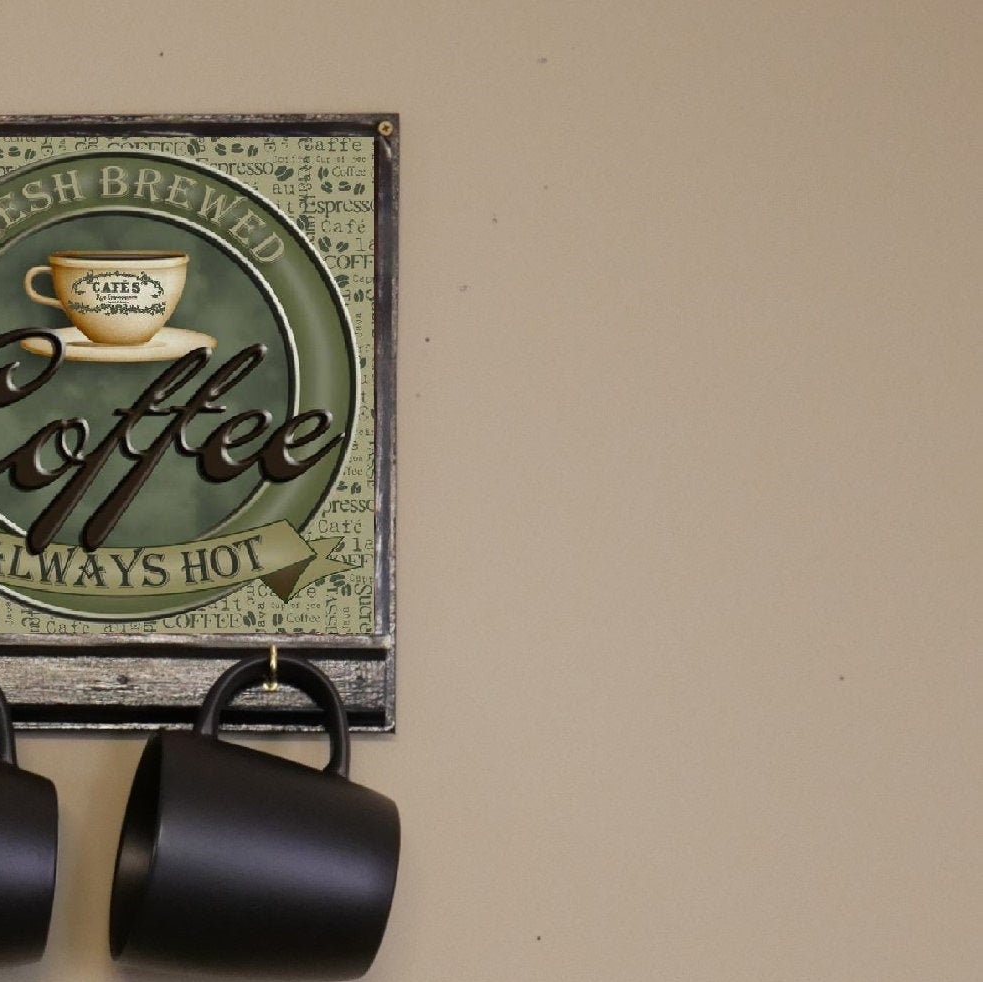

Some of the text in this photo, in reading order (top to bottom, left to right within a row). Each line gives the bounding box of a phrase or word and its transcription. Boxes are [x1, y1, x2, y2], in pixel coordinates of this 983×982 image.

[99, 165, 285, 264] BREWED
[321, 218, 366, 234] Café
[181, 535, 264, 584] HOT
